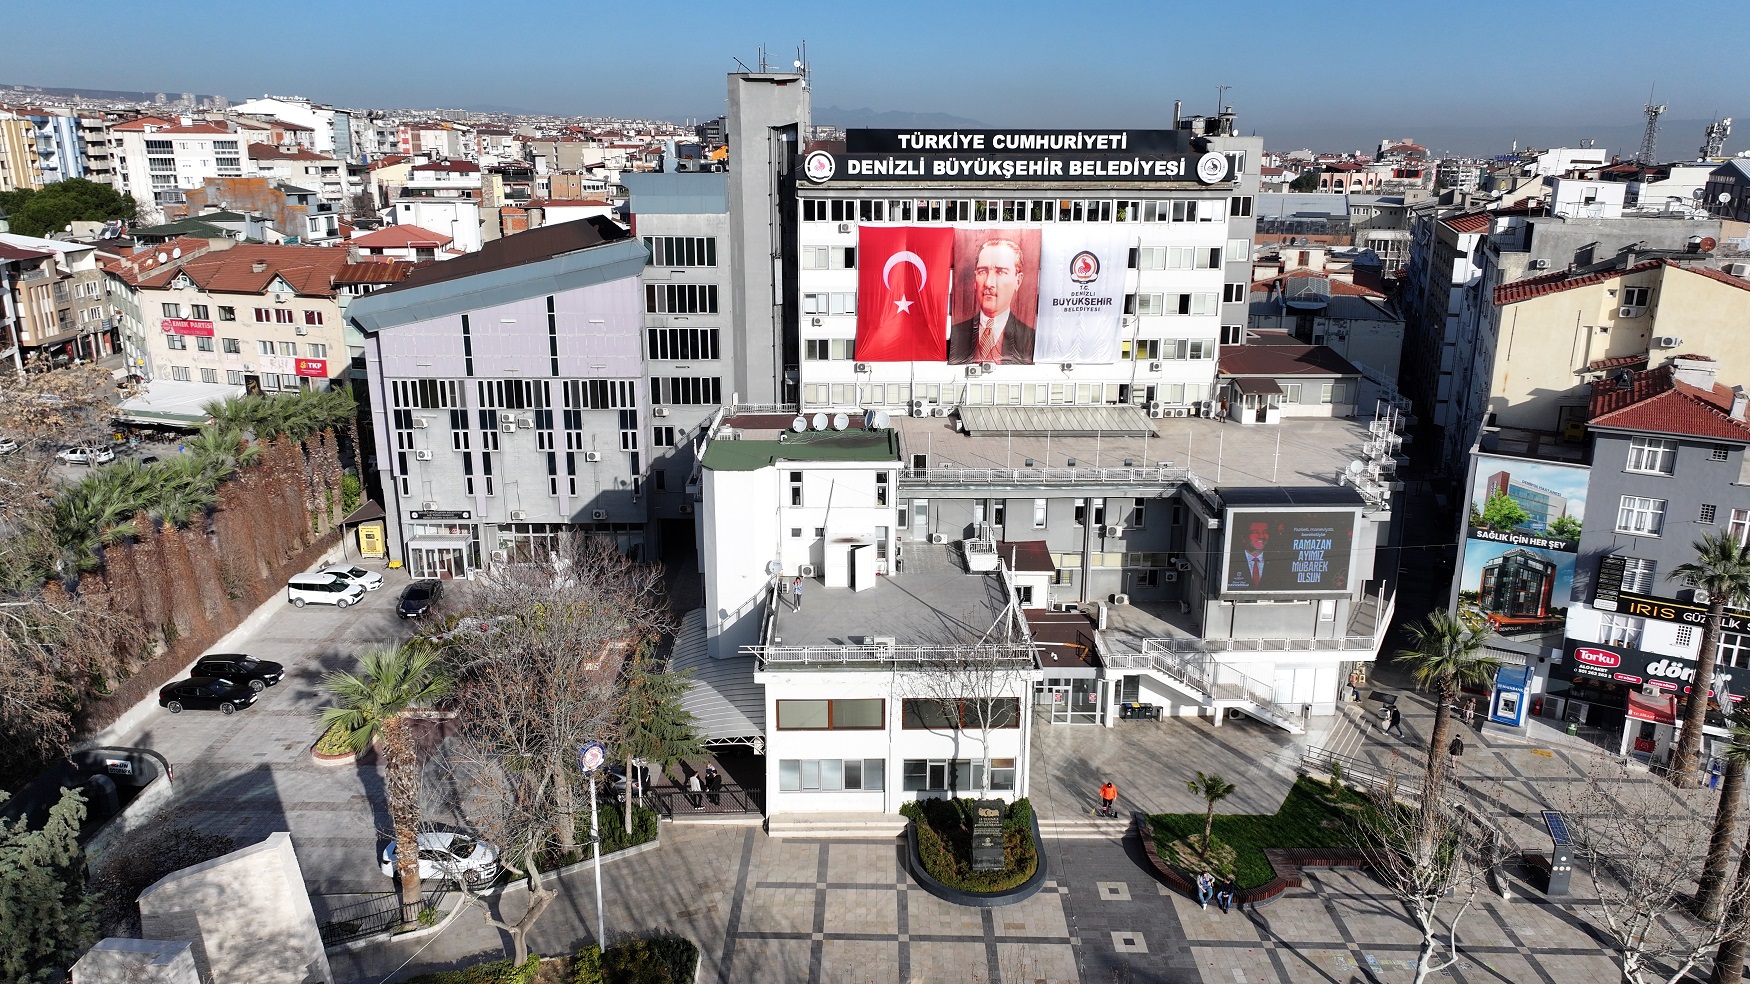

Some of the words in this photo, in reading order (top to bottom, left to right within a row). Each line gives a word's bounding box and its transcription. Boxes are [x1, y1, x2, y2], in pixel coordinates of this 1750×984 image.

[898, 131, 985, 149] TÜRKİYE
[992, 132, 1128, 149] CUMHURİYETİ
[847, 157, 925, 175] DENİZLİ
[933, 157, 1063, 178] BÜYÜKŞEHİR
[1069, 157, 1185, 176] BELEDİYESİ
[1052, 297, 1112, 306] BÜYÜKŞEHİR
[1293, 539, 1332, 550] RAMAZAN
[1477, 530, 1508, 542] SAĞLIK
[1509, 534, 1529, 545] İÇİN
[1529, 538, 1548, 548] HER
[1548, 540, 1566, 550] ŞEY
[1298, 550, 1324, 561] AYIMIZ
[1292, 561, 1328, 572] MÜBAREK
[1297, 572, 1321, 583] OLSUN
[1683, 612, 1741, 629] GÜZLİK
[1580, 650, 1615, 664] Torku
